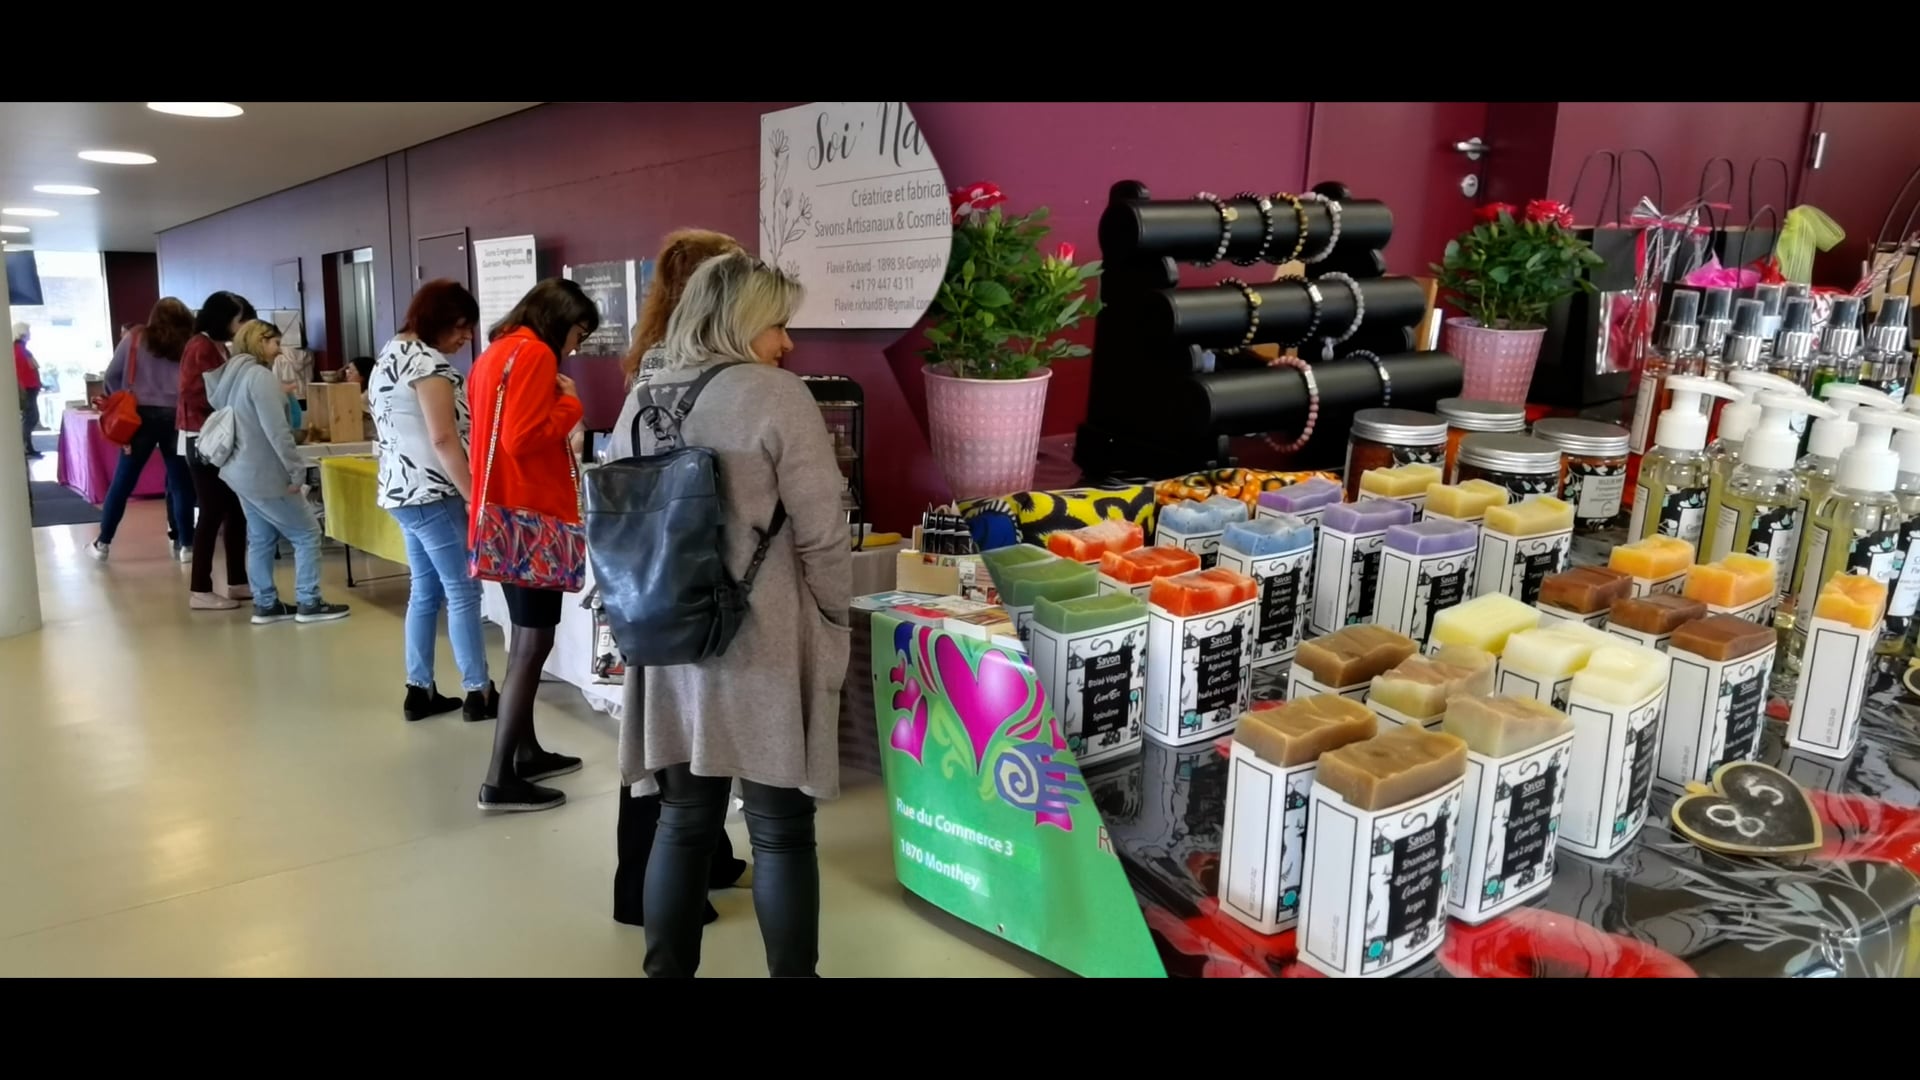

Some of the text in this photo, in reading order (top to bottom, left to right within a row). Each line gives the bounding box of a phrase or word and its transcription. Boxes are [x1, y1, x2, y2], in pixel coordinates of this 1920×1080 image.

[852, 185, 893, 207] Créatrice
[895, 184, 905, 203] et
[815, 207, 952, 238] Savons Artisanaux & Cosméti
[846, 257, 872, 273] Richard
[878, 256, 896, 271] 1898
[1208, 634, 1233, 650] Savon
[1095, 654, 1121, 670] Savon
[1520, 778, 1546, 798] Savon
[895, 796, 1014, 858] Rue du Commerce 3
[1406, 828, 1436, 853] Savon
[900, 838, 980, 890] 1870 Monthey
